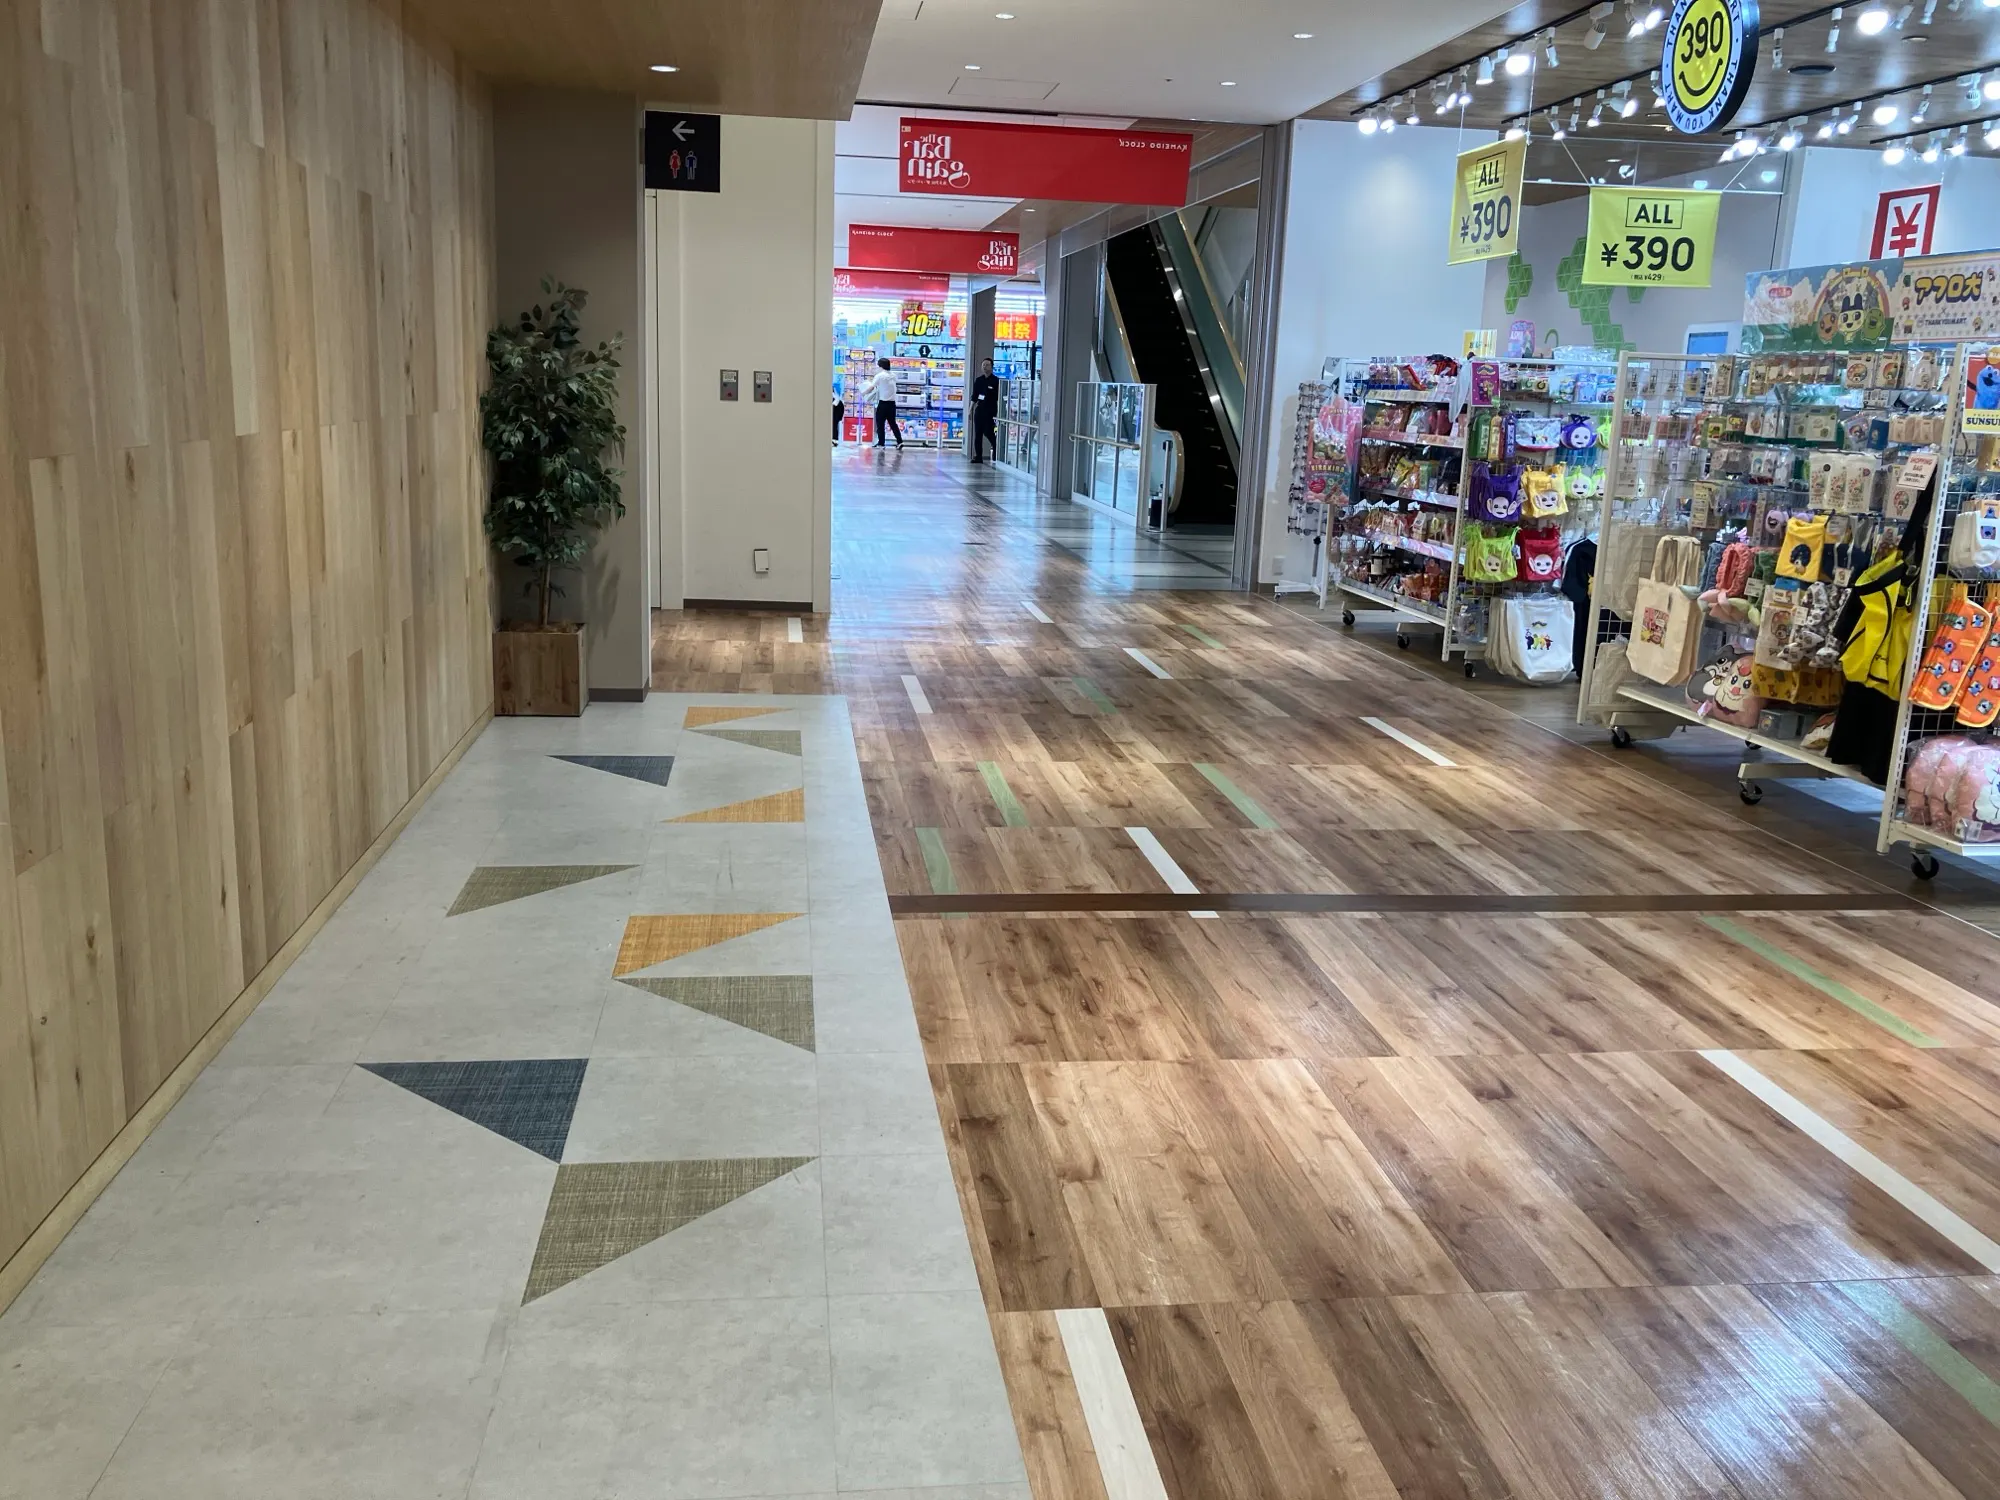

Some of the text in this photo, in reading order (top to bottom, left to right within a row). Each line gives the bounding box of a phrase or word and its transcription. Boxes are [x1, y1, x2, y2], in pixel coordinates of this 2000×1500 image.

[1681, 11, 1724, 64] 390
[1664, 60, 1738, 130] THANK YOU MART
[1478, 159, 1500, 188] ALL
[1460, 195, 1512, 244] ¥390
[1633, 203, 1674, 224] ALL
[989, 240, 1017, 256] Bar
[1600, 235, 1695, 272] ¥390
[977, 254, 1014, 271] gain
[907, 314, 929, 336] 10
[1966, 417, 2000, 426] SUNSU
